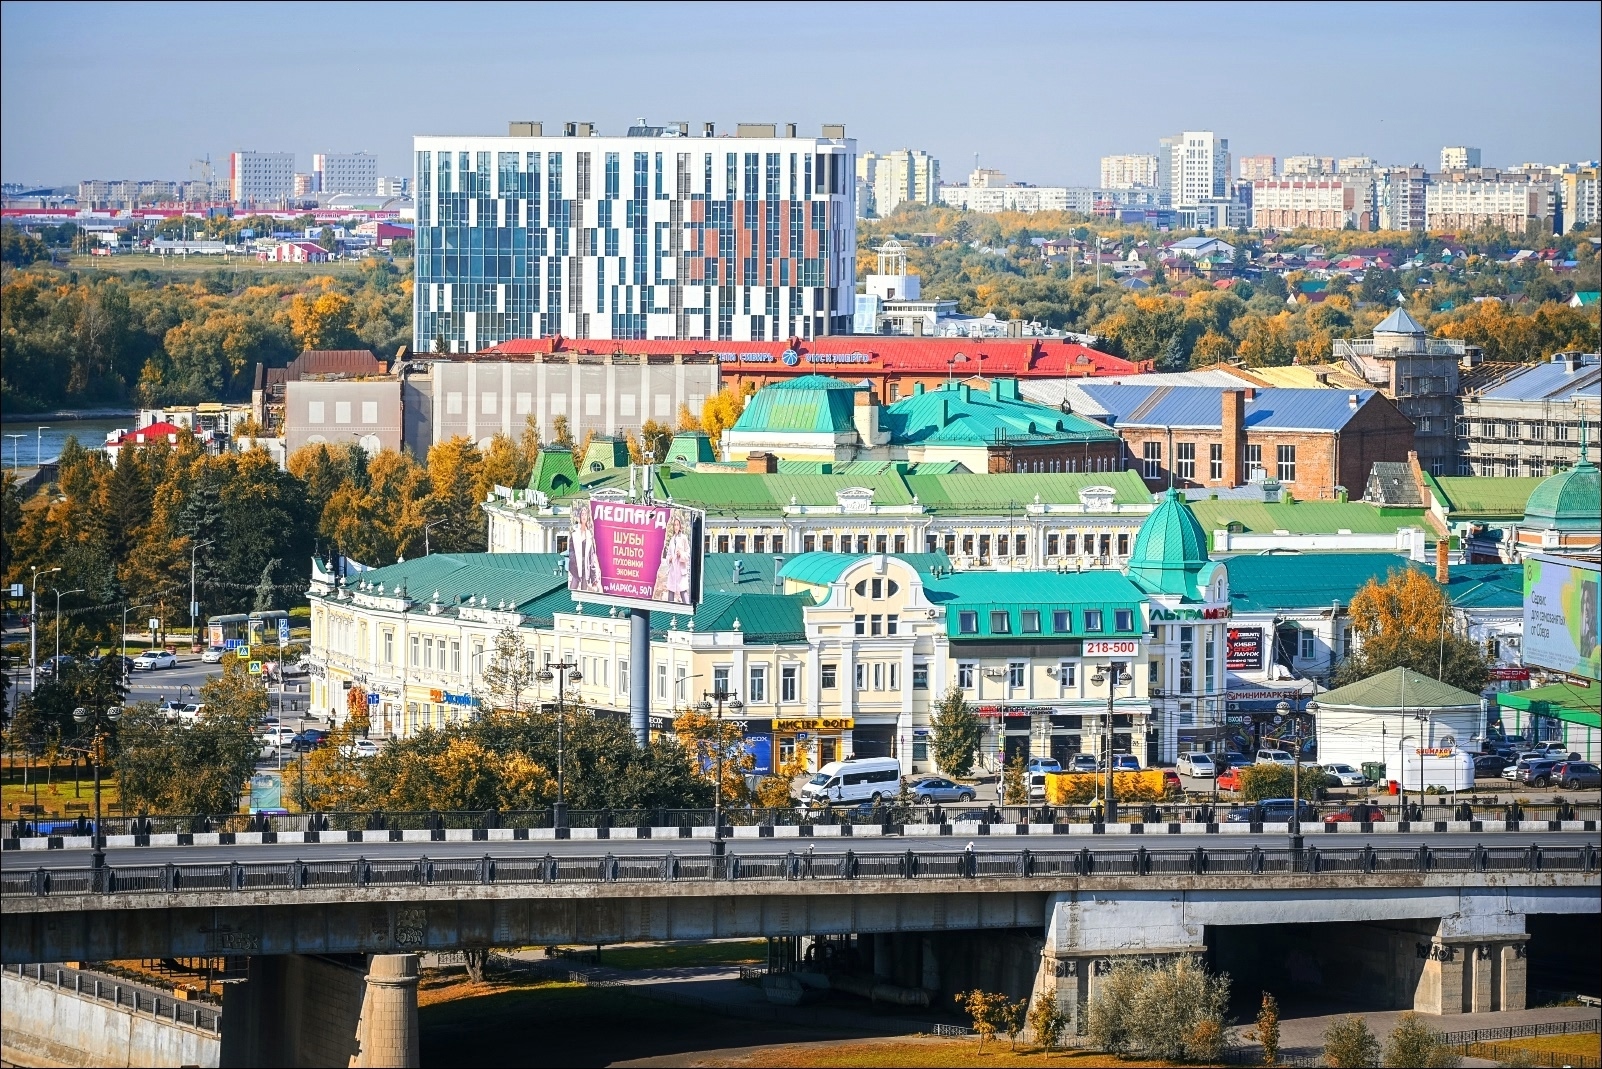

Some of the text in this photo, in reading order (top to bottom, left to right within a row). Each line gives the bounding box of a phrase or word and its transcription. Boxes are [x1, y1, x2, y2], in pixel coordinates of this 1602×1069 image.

[593, 504, 667, 529] ЛЕОПАРД
[613, 531, 644, 546] ШУБЫ
[613, 545, 644, 558] ПАЛЬТО
[612, 557, 643, 568] ПУХОВИКИ
[616, 568, 640, 577] ЭКОМЕХ
[1531, 590, 1547, 607] Сервис
[1149, 605, 1233, 620] ЛЬТРАМЕД
[1537, 623, 1550, 640] Сбера
[1087, 642, 1135, 653] 218-500
[649, 716, 663, 724] EOX
[777, 720, 818, 730] МИСТЕР
